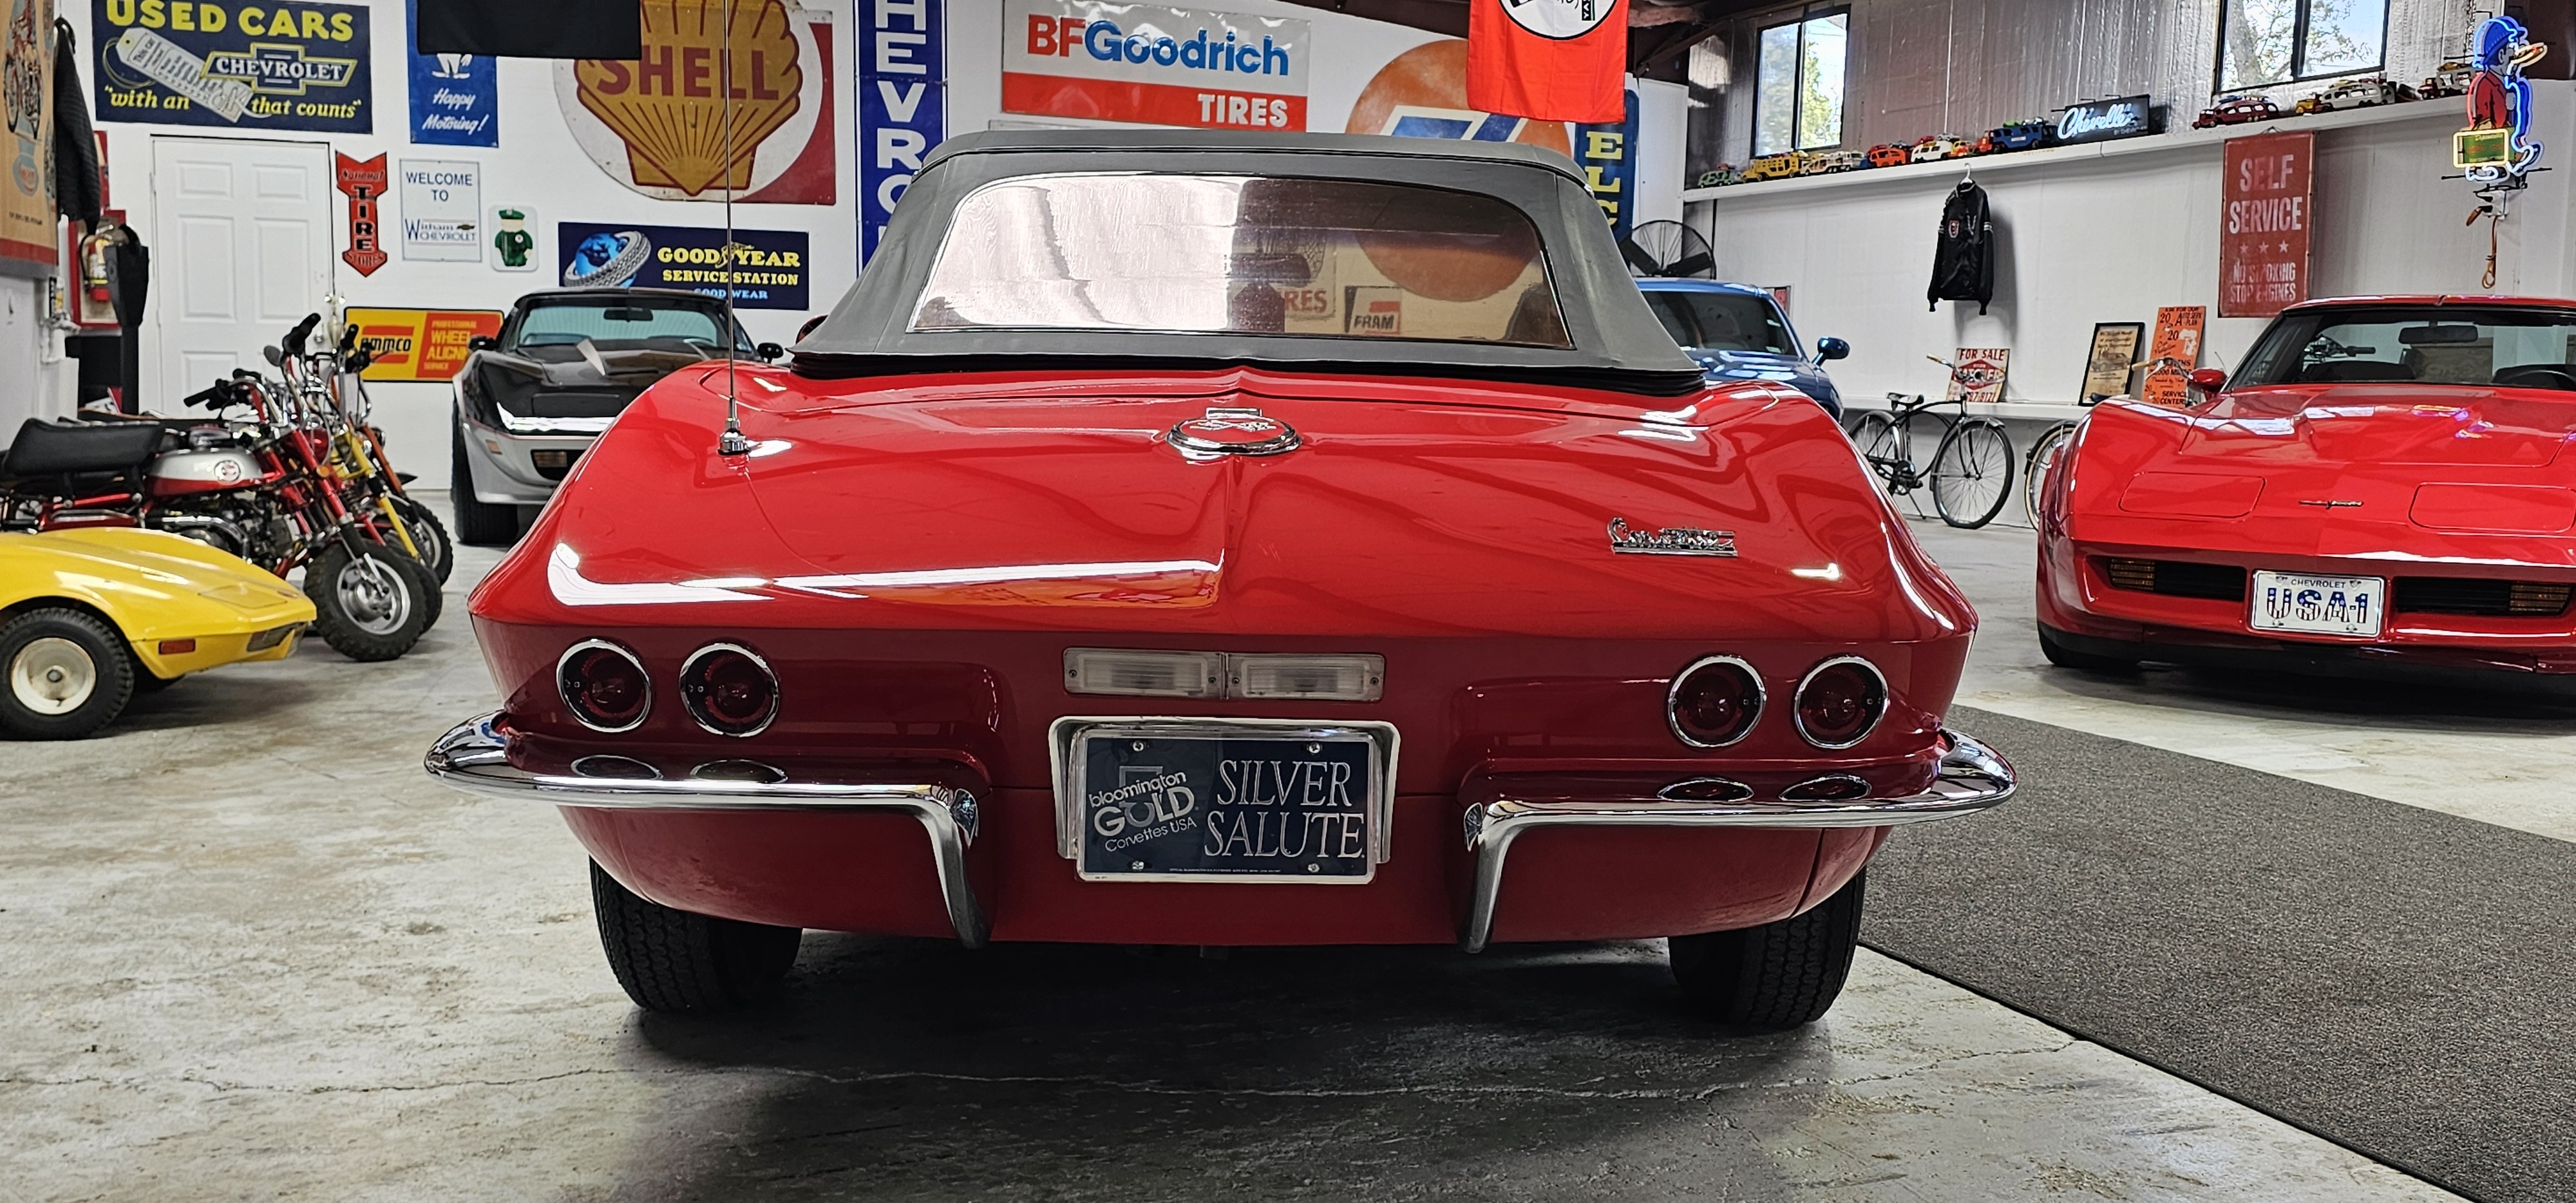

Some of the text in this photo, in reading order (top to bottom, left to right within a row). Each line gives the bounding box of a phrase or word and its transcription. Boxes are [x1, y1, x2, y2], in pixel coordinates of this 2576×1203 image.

[107, 0, 354, 42] USED CARS
[1027, 14, 1289, 76] BFGoodrich
[216, 57, 343, 81] CHEVROLET
[597, 45, 779, 100] SHELL
[164, 94, 190, 110] an
[251, 95, 292, 115] that
[433, 87, 476, 111] Happy
[1198, 93, 1288, 128] TIRES
[422, 113, 489, 135] Motoring!
[876, 0, 926, 245] HEVRO
[2057, 104, 2134, 139] Chevelle
[406, 171, 473, 187] WELCOME
[2239, 154, 2294, 192] SELF
[431, 189, 449, 202] TO
[351, 184, 375, 252] TIRE
[2229, 196, 2303, 234] SERVICE
[420, 230, 476, 242] CHEVROLET
[663, 269, 799, 285] SERVICE STATION
[2233, 261, 2246, 283] NO
[694, 288, 768, 299] GOOD WEAR
[2230, 284, 2253, 303] STOP
[1354, 314, 1394, 330] FRAM
[2160, 312, 2171, 323] 20
[2167, 330, 2179, 341] 20
[1959, 348, 2005, 361] FOR SALE
[2291, 578, 2346, 589] CHEVROLET
[1088, 772, 1187, 808] bloomington
[1217, 759, 1352, 807] SILVER
[1094, 786, 1195, 837] GOLD
[1104, 817, 1197, 852] Corvettes USA
